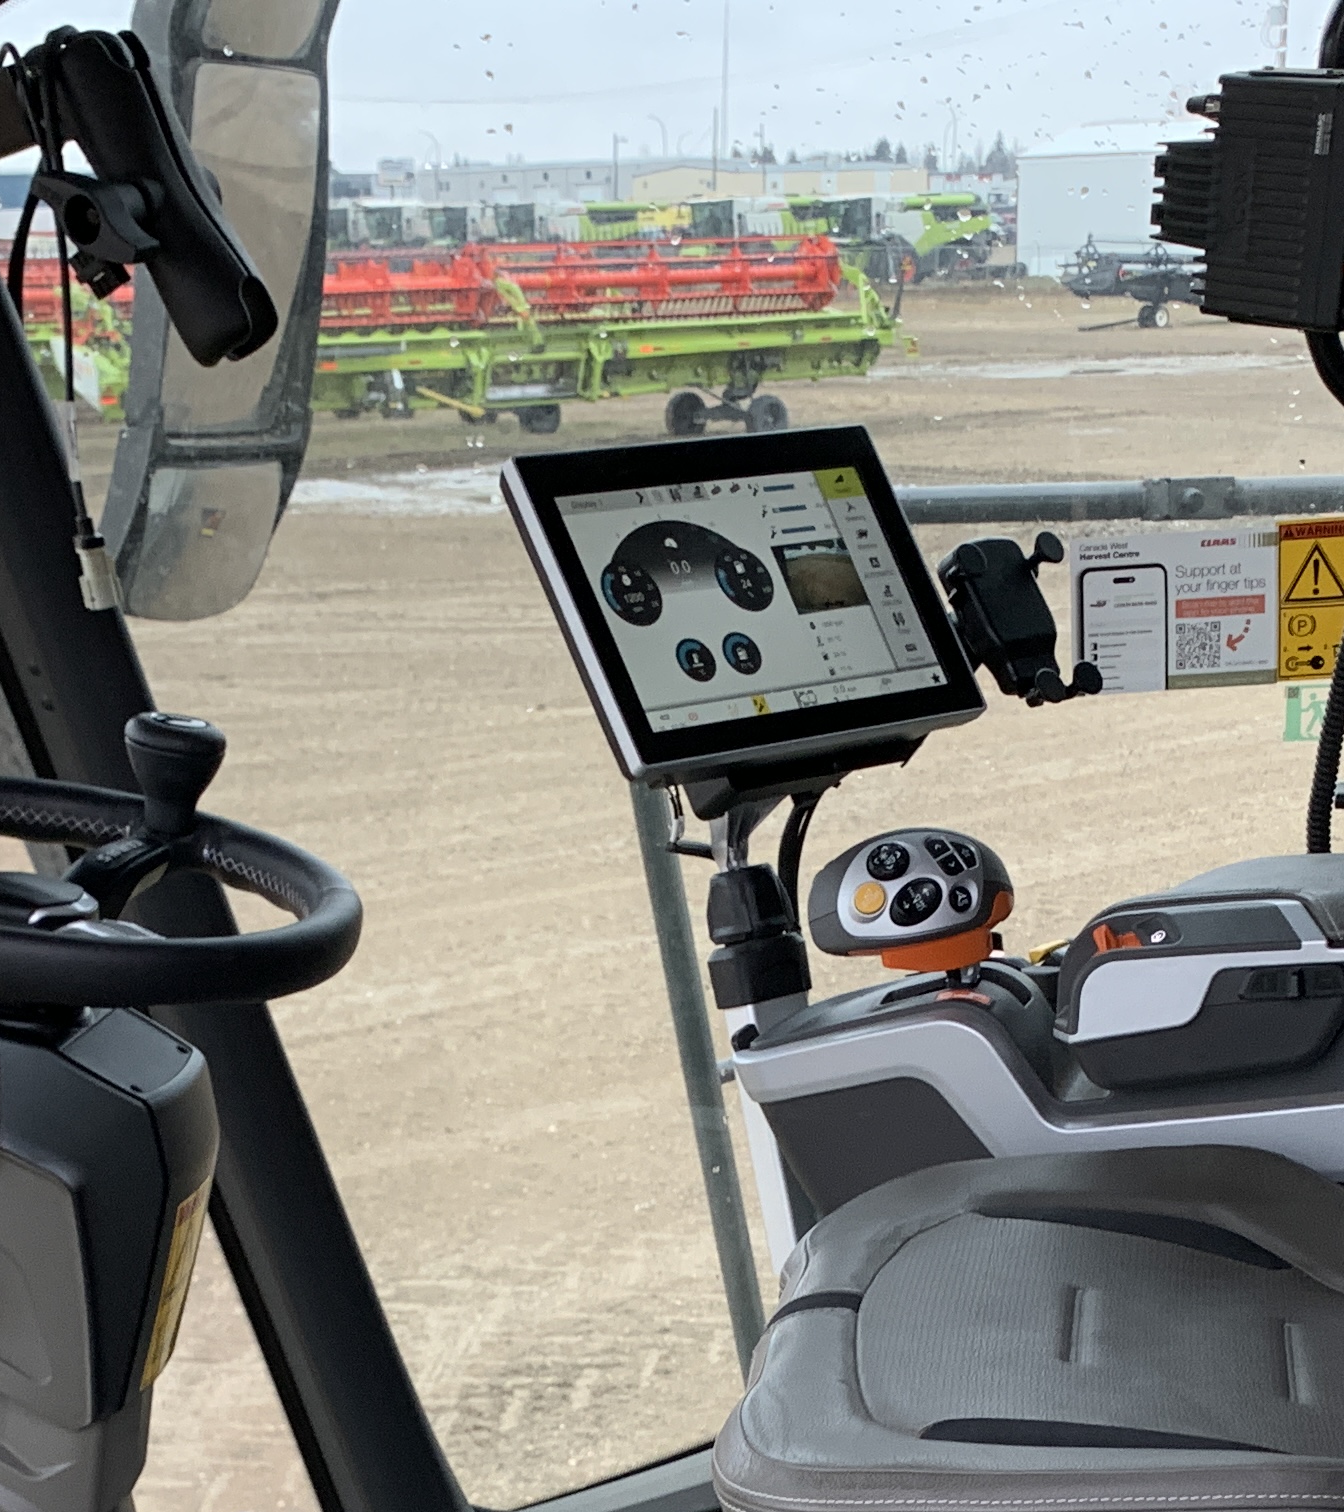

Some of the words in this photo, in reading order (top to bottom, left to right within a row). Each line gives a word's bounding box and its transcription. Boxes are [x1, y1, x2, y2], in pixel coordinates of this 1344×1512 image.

[1079, 543, 1108, 552] Canada
[1110, 542, 1129, 550] West
[1200, 538, 1236, 547] CLAAS
[1079, 552, 1111, 561] Harvest
[1112, 550, 1140, 559] Centre
[1174, 563, 1226, 579] Support
[1229, 562, 1242, 575] at
[1174, 582, 1202, 596] your
[1206, 578, 1240, 593] finger
[1244, 577, 1266, 590] tips
